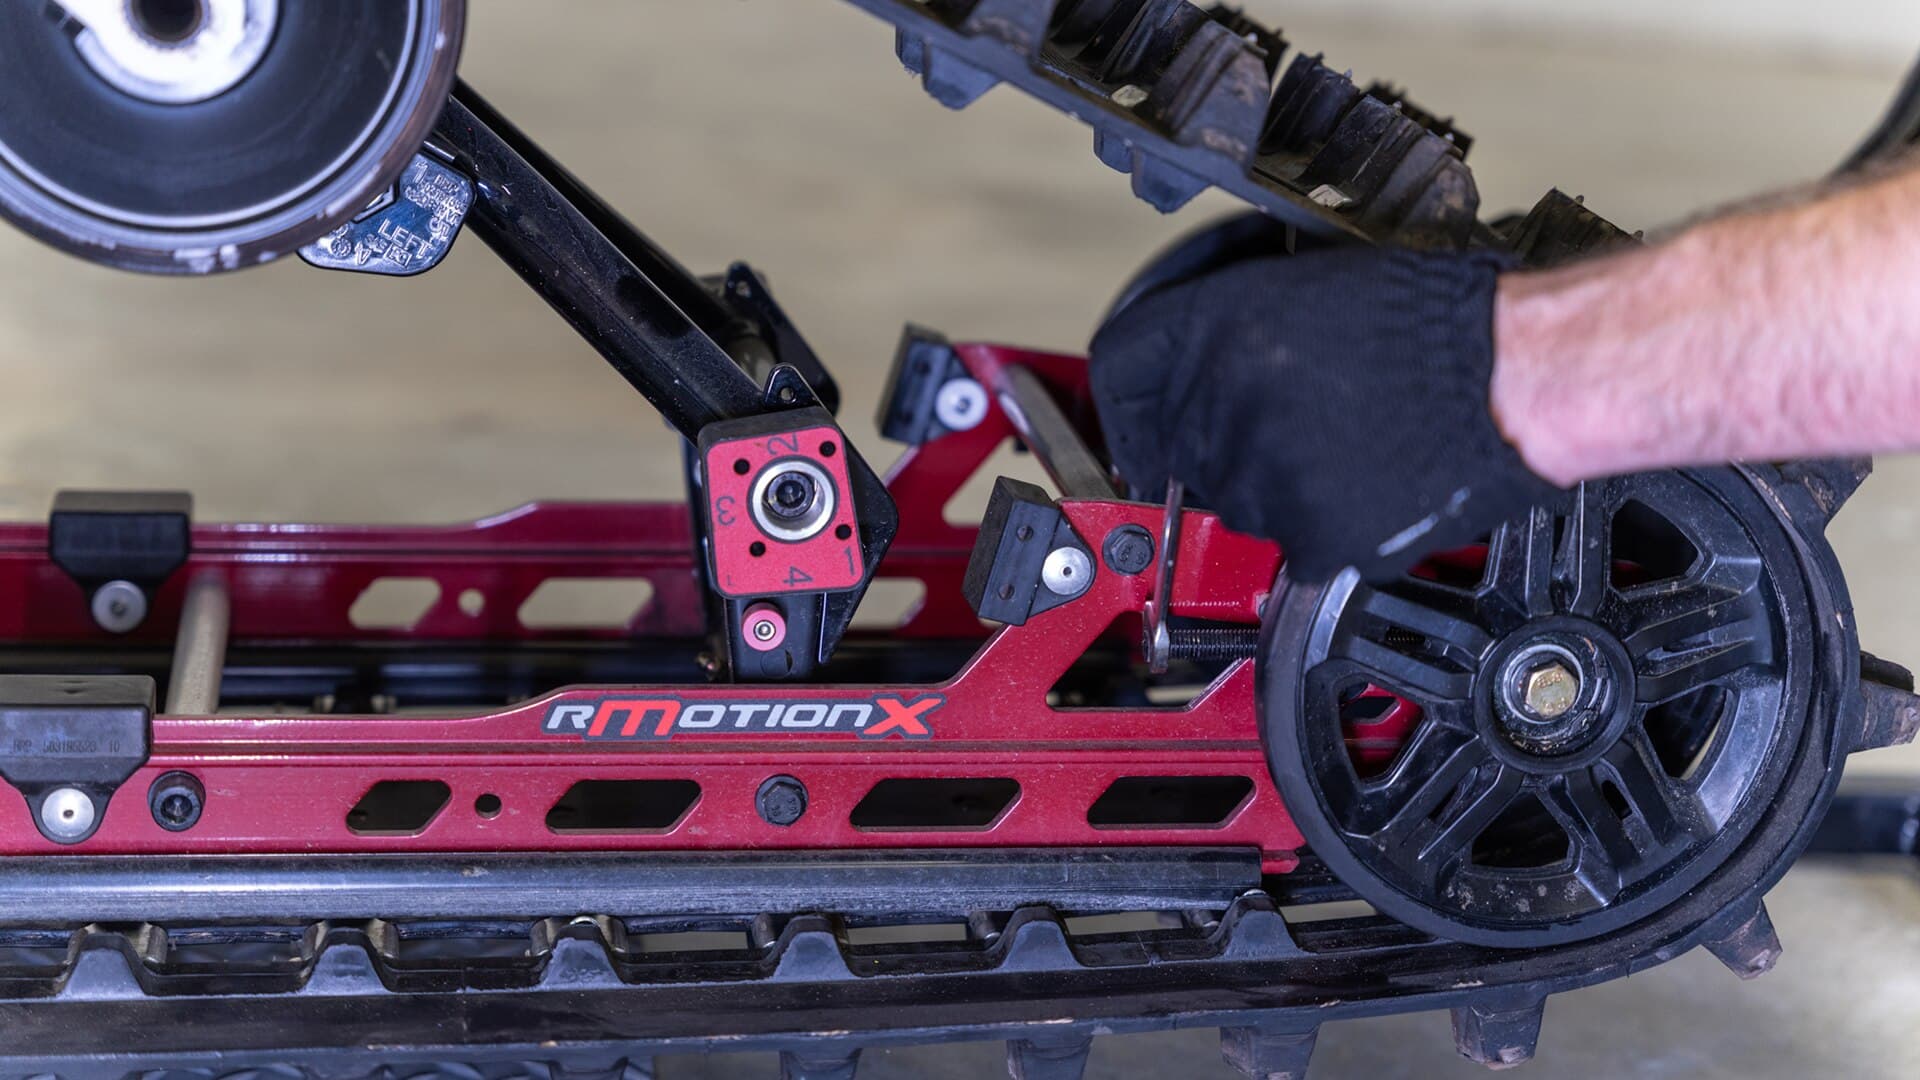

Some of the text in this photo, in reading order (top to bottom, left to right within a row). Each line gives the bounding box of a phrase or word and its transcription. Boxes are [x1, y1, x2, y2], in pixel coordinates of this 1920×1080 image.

[378, 218, 436, 259] LEFT
[766, 432, 799, 456] 2
[715, 495, 736, 527] 3
[783, 565, 813, 587] 4
[842, 545, 856, 576] 1
